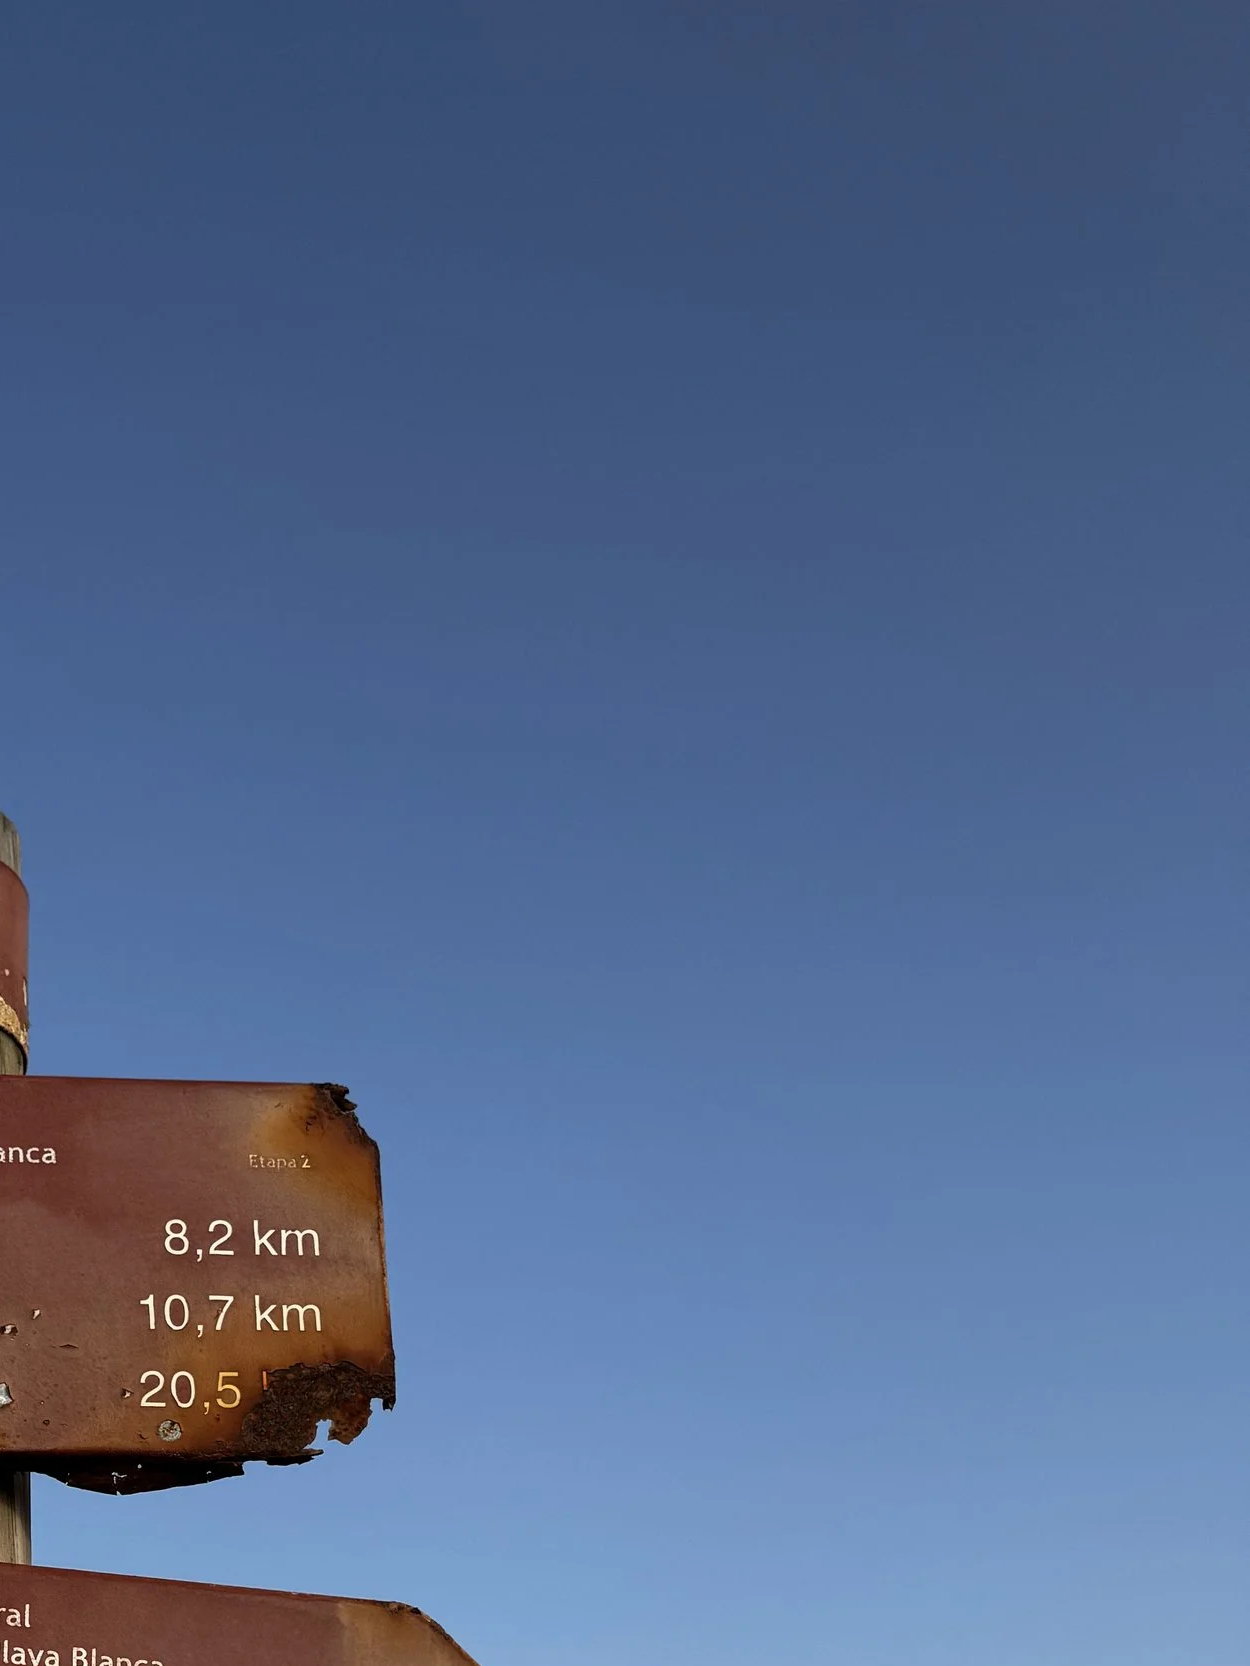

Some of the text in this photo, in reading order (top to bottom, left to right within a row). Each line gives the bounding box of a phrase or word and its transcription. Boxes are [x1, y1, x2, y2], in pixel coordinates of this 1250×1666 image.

[249, 1154, 311, 1171] Etapa 2
[163, 1218, 320, 1262] 8,2 km
[139, 1293, 322, 1337] 10,7 km
[139, 1370, 242, 1415] 20,5
